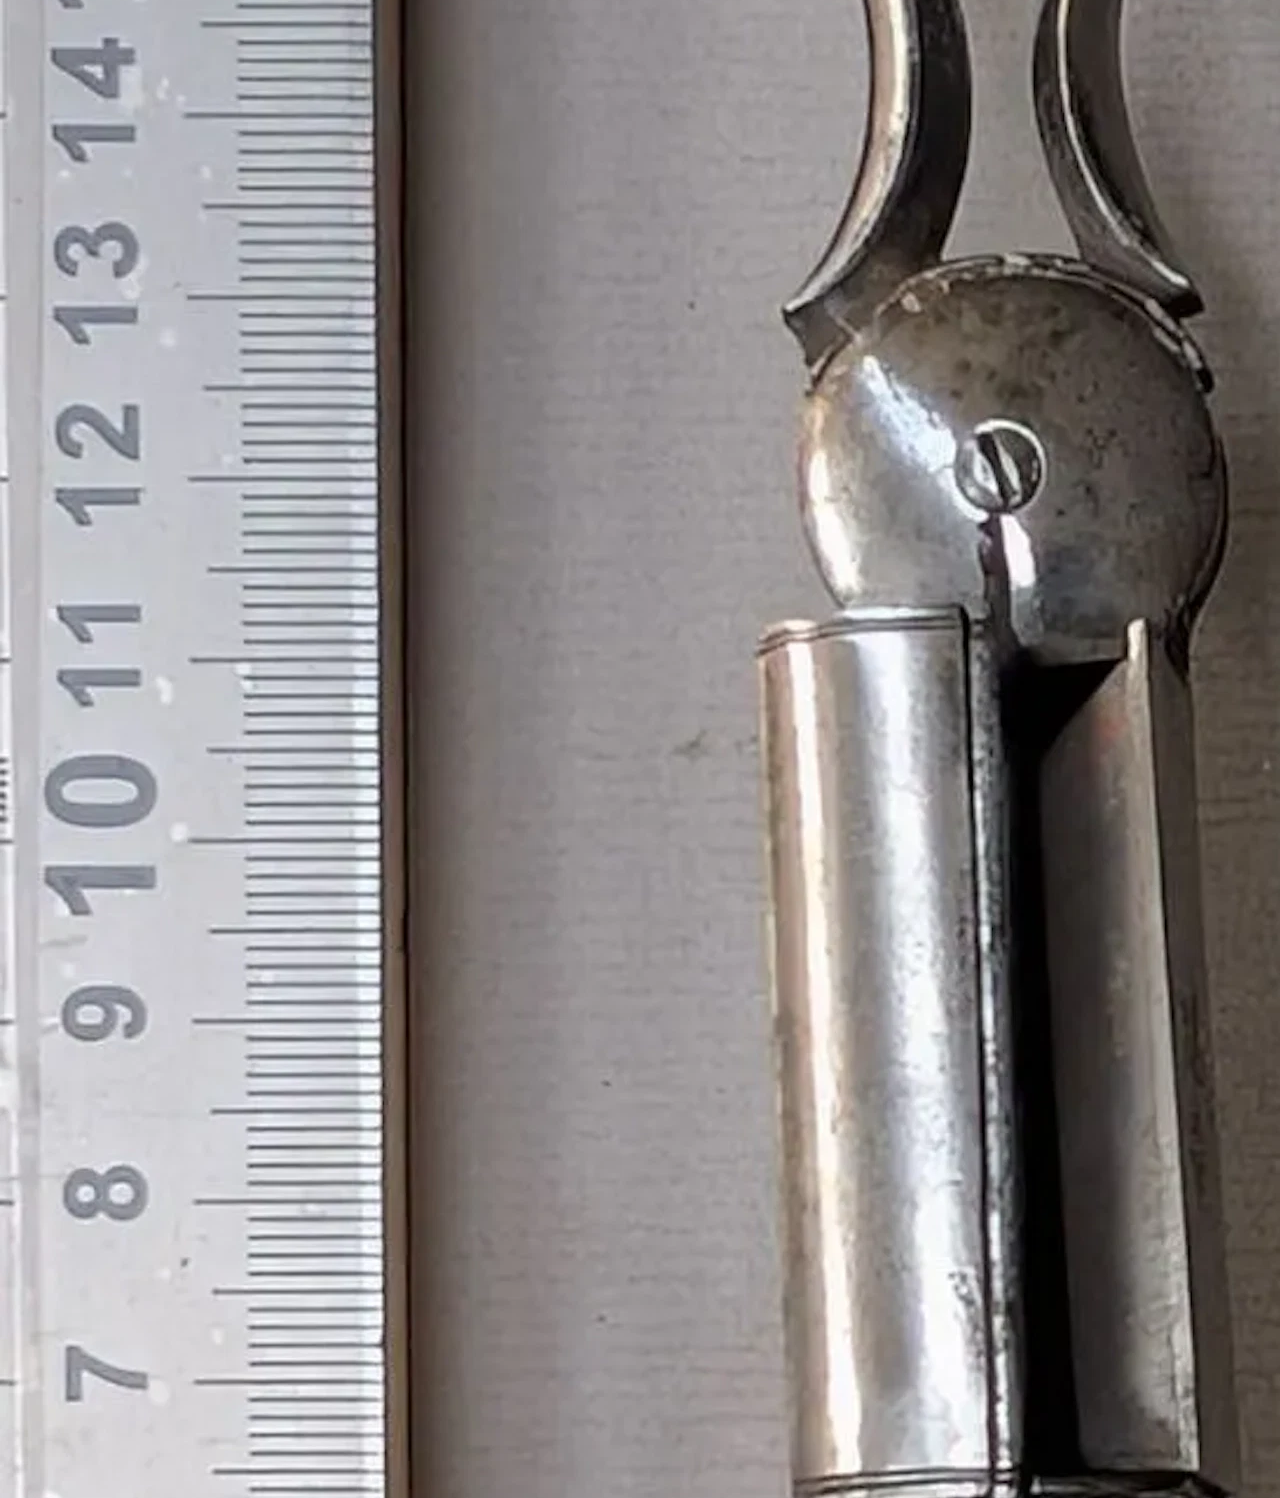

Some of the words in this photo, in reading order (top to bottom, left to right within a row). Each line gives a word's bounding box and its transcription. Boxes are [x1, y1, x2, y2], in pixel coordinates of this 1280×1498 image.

[51, 37, 136, 164] 14
[53, 221, 139, 346] 13
[55, 403, 144, 527] 12
[56, 604, 142, 708] 11
[44, 755, 158, 917] 10
[61, 985, 147, 1043] 9
[62, 1164, 148, 1222] 8
[64, 1344, 149, 1403] 7
